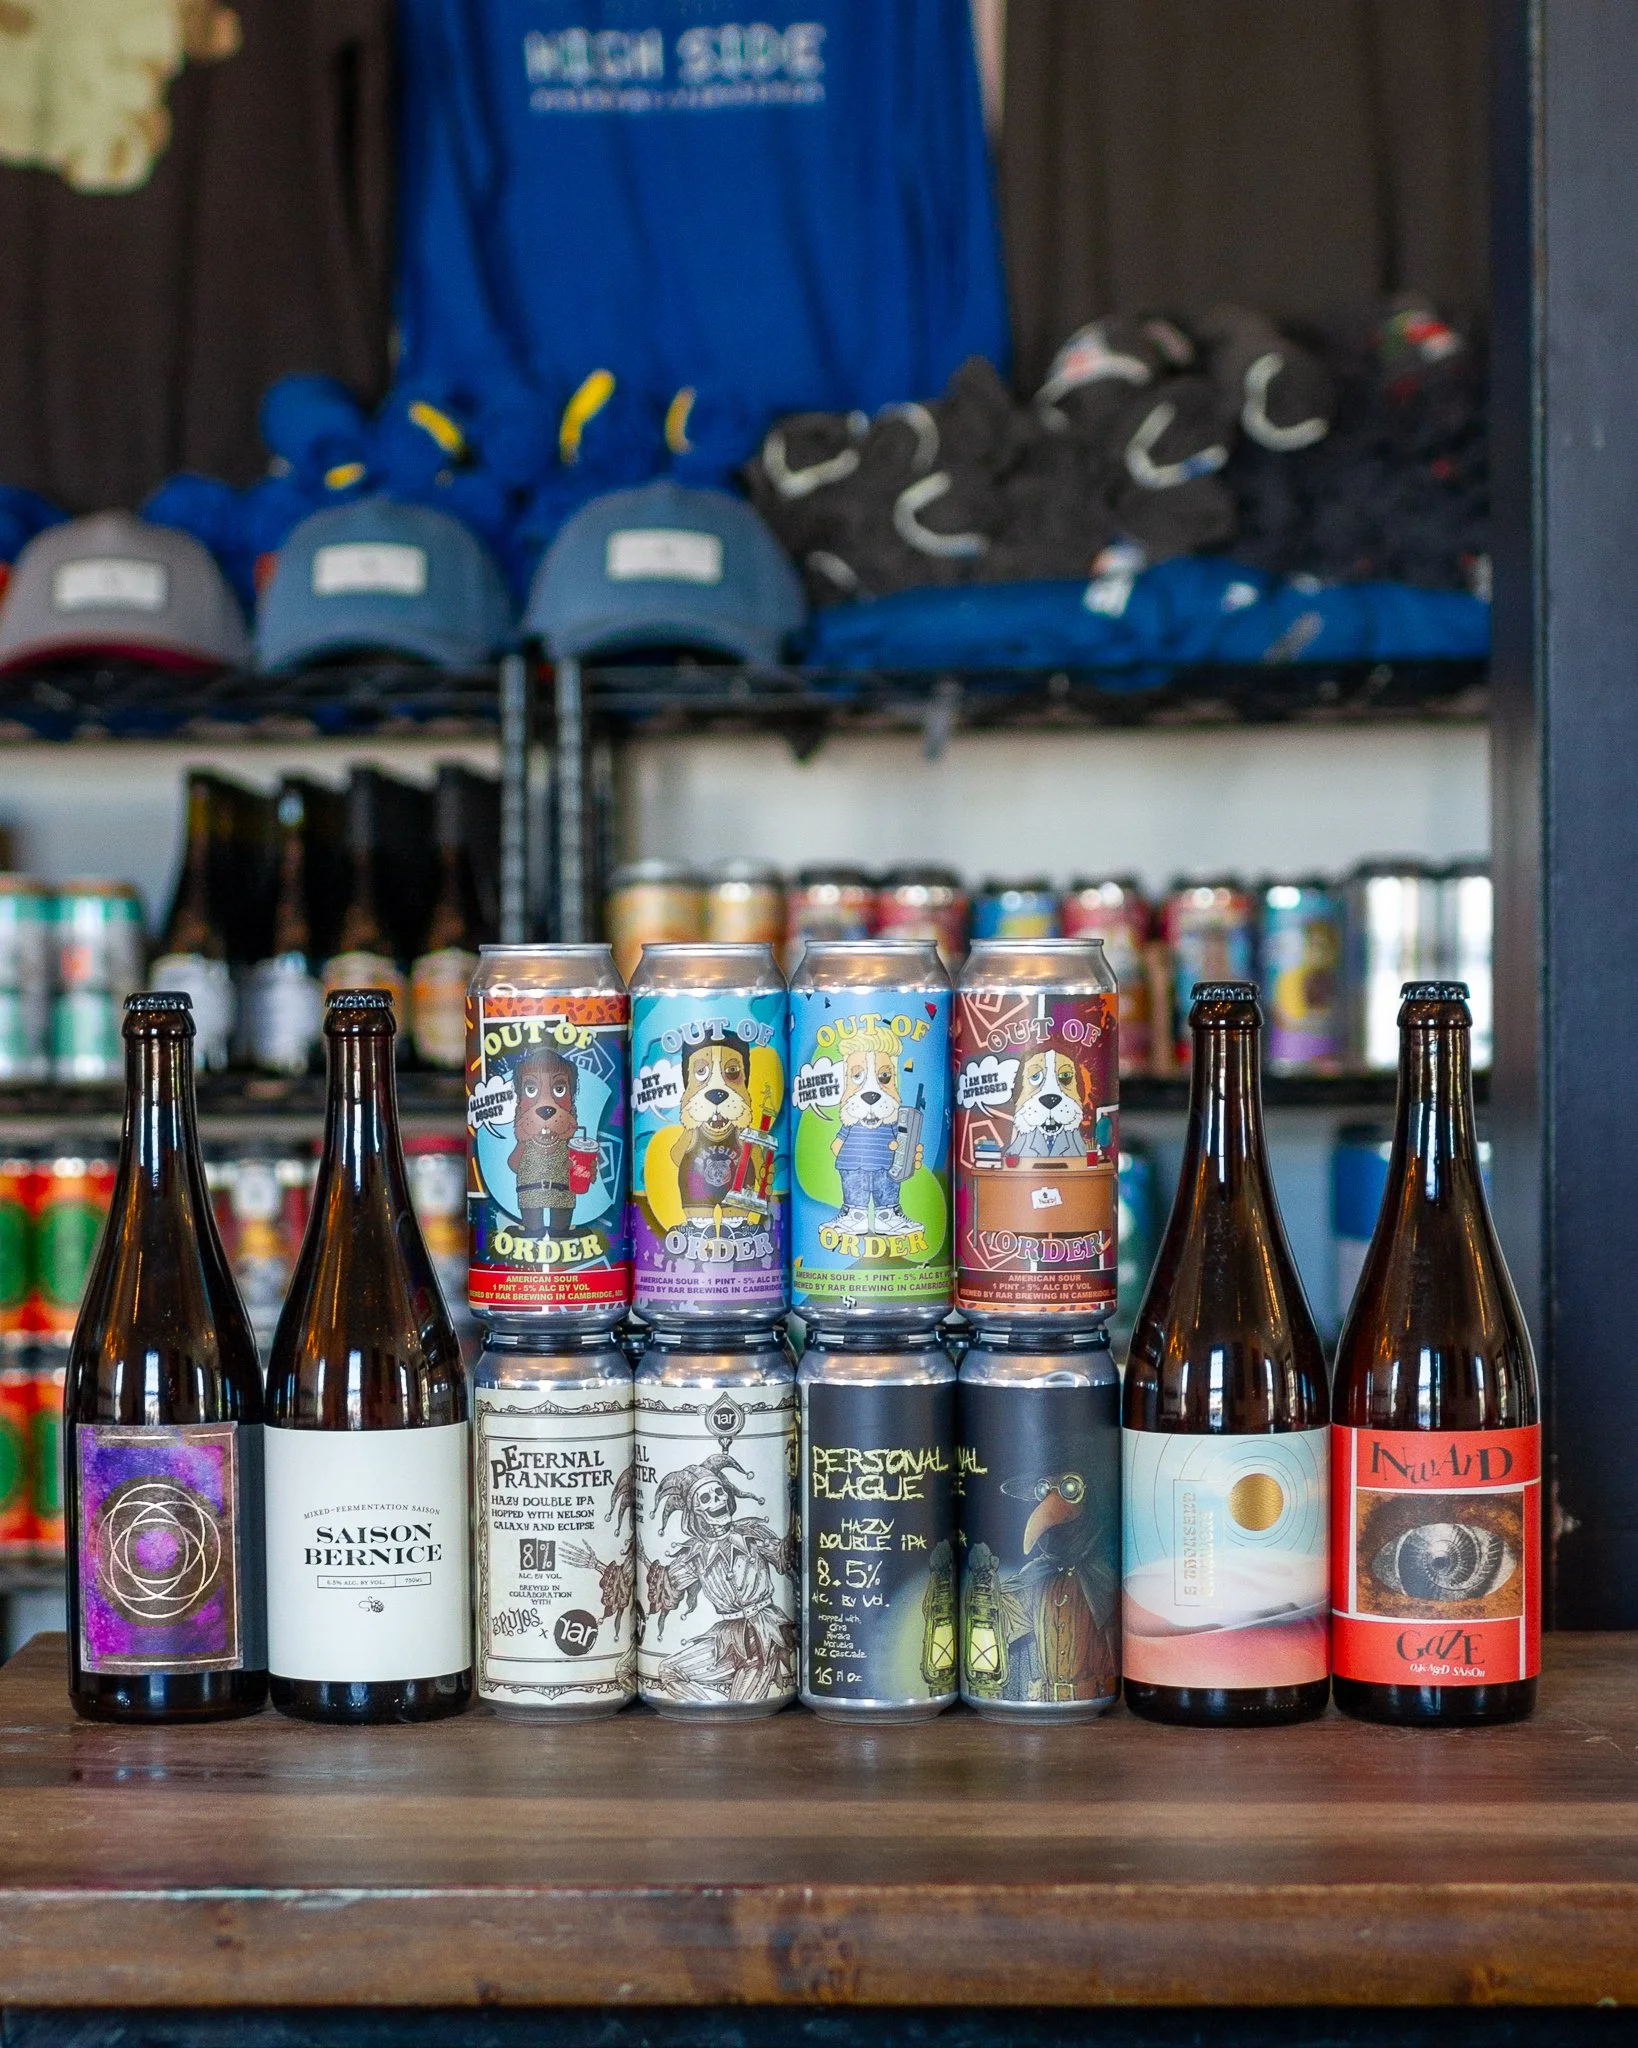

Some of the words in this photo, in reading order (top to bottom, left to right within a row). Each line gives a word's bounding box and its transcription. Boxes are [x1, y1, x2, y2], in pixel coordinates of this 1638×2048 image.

[485, 1021, 546, 1056] OUT
[554, 1022, 598, 1049] OF
[661, 1017, 731, 1054] OUT
[737, 1018, 774, 1047] OF
[816, 1012, 882, 1048] OUT
[890, 1014, 931, 1042] OF
[986, 1016, 1055, 1053] OUT
[1062, 1019, 1101, 1047] OF
[641, 1073, 660, 1090] HEY
[965, 1078, 968, 1088] I
[969, 1076, 980, 1087] AM
[981, 1072, 998, 1084] NOT
[637, 1083, 678, 1105] PREPPY!
[799, 1088, 818, 1103] TIME
[819, 1084, 840, 1098] OUT
[963, 1082, 1008, 1099] IMPRESSED
[494, 1231, 603, 1263] ORDER
[665, 1230, 774, 1263] ORDER
[820, 1227, 929, 1258] ORDER
[995, 1230, 1104, 1263] ORDER
[506, 1275, 551, 1283] AMERICAN
[554, 1275, 578, 1283] SOUR
[640, 1276, 674, 1285] AMERICAN
[743, 1277, 755, 1285] 5%
[772, 1275, 780, 1283] BY
[796, 1271, 828, 1280] AMERICAN
[830, 1273, 856, 1281] SOUR
[904, 1273, 916, 1281] 5%
[919, 1272, 933, 1280] ALC
[1008, 1274, 1056, 1282] AMERICAN
[1058, 1274, 1081, 1282] SOUR
[538, 1284, 557, 1292] ALC
[559, 1284, 571, 1292] BY
[572, 1283, 590, 1291] VOL
[687, 1286, 729, 1294] BREWING
[849, 1284, 894, 1292] BREWING
[995, 1291, 1013, 1299] RAR
[1015, 1292, 1057, 1300] BREWING
[501, 1445, 605, 1471] ETERNAL
[812, 1445, 949, 1475] PERSONAL
[491, 1459, 615, 1489] PRANKSTER
[812, 1472, 925, 1501] PLAGUE
[491, 1495, 519, 1506] HAZY
[523, 1495, 572, 1507] DOUBLE
[576, 1495, 595, 1506] IPA
[303, 1503, 409, 1519] MIXED-FERMENTATION
[412, 1505, 440, 1515] SAISON
[491, 1509, 523, 1519] HOPPED
[527, 1510, 554, 1519] WITH
[557, 1509, 595, 1519] NELSON
[316, 1523, 432, 1544] SAISON
[493, 1521, 530, 1531] GALAXY
[533, 1522, 555, 1531] AND
[558, 1521, 595, 1531] ECLIPSE
[841, 1518, 895, 1534] HAZY
[820, 1532, 892, 1551] DOUBLE
[304, 1544, 442, 1565] BERNICE
[522, 1542, 554, 1570] 8%
[817, 1556, 883, 1589] 8.5%
[815, 1648, 827, 1657] NZ
[815, 1667, 833, 1685] 16
